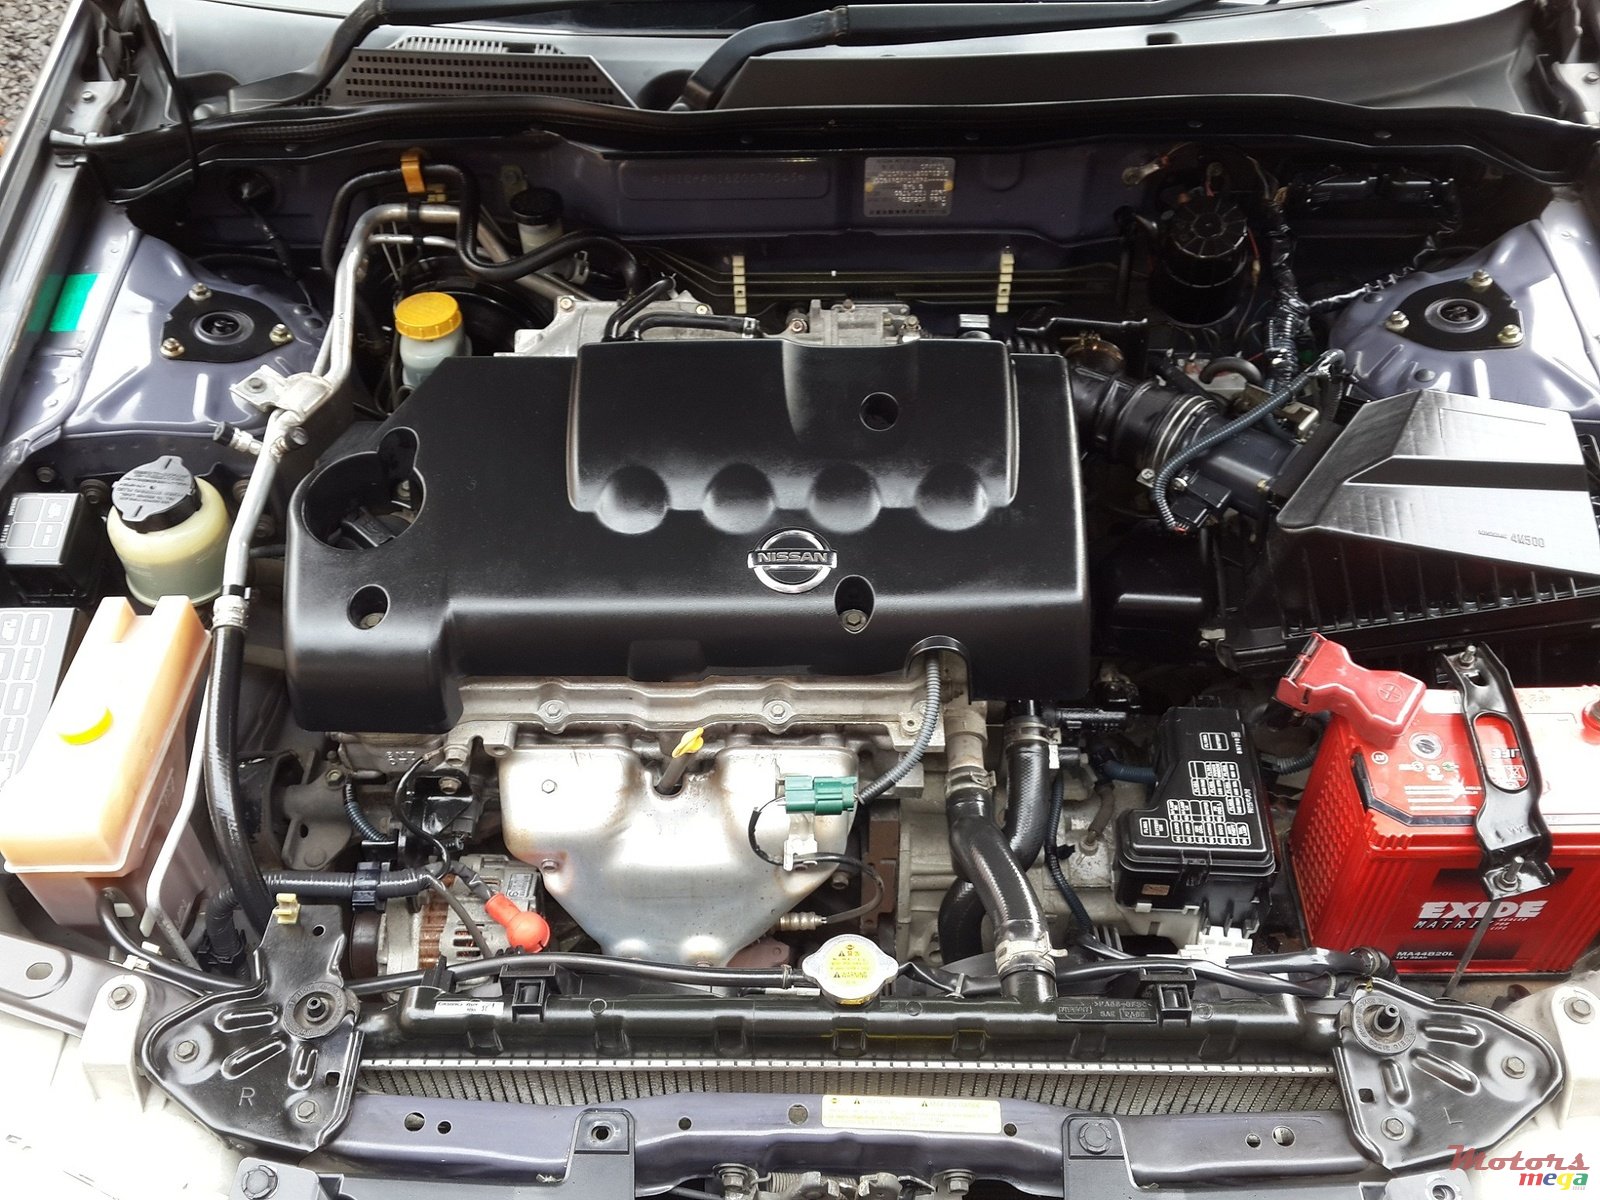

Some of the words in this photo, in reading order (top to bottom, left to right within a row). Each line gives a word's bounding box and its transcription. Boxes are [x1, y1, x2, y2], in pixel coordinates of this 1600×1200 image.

[1510, 532, 1545, 548] 4M500
[757, 552, 828, 563] NISSAN
[1418, 900, 1549, 919] EXIDE
[1414, 919, 1494, 930] MATRI
[238, 1086, 256, 1107] R
[1442, 1106, 1464, 1125] L
